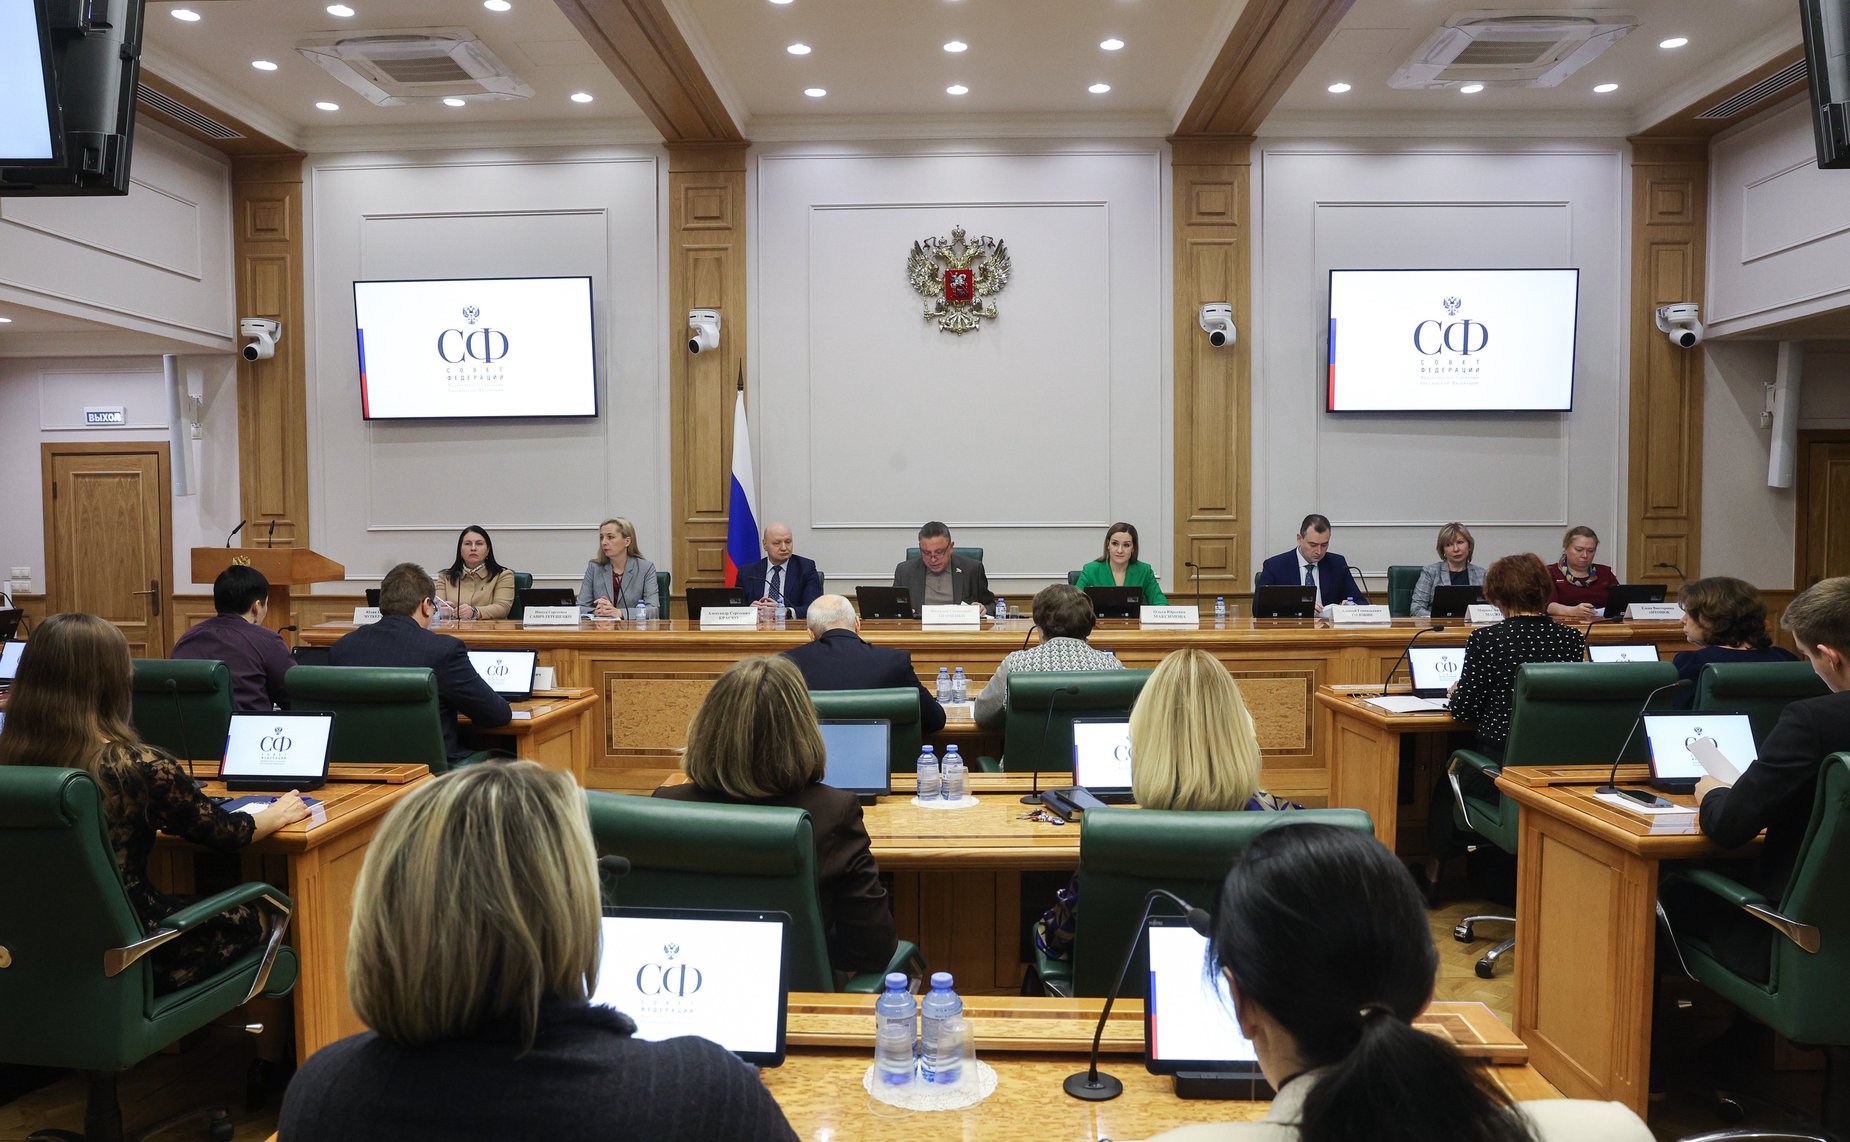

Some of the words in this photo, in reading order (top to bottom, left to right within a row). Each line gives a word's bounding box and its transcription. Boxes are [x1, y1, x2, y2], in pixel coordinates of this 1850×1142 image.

[437, 328, 509, 363] СФ
[1413, 319, 1489, 355] СФ
[88, 413, 122, 422] ВЫХОД
[260, 736, 292, 752] СФ
[636, 963, 703, 997] СФ
